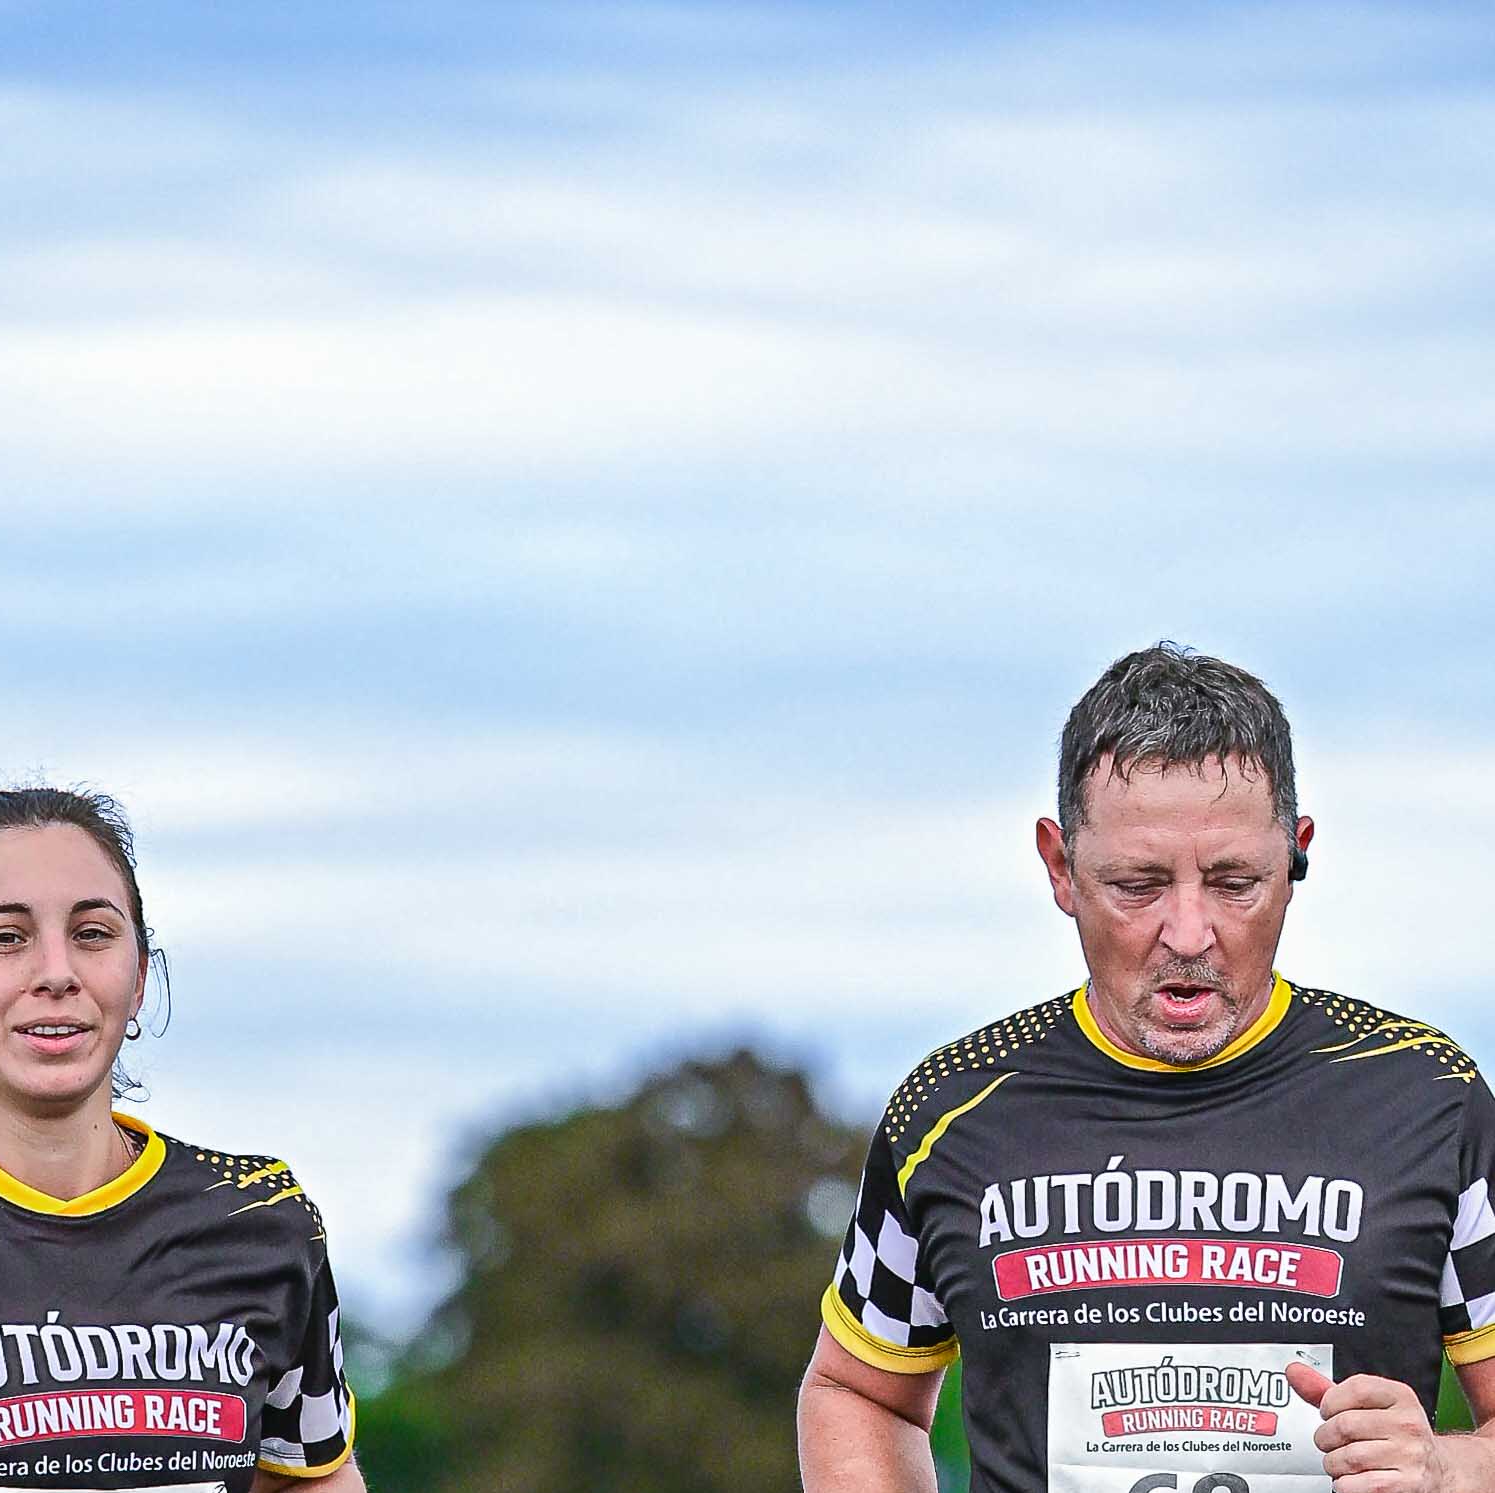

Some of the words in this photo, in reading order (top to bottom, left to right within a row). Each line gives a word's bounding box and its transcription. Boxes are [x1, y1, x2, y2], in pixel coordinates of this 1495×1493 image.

[977, 1155, 1365, 1249] AUTÓDROMO
[1023, 1243, 1188, 1291] RUNNING
[1200, 1244, 1302, 1287] RACE
[980, 1310, 997, 1330] La
[998, 1306, 1068, 1328] Carrera
[1074, 1302, 1102, 1325] de
[1107, 1302, 1141, 1323] los
[1145, 1301, 1224, 1323] Clubes
[1229, 1300, 1265, 1323] del
[1270, 1301, 1366, 1327] Noroeste
[1090, 1356, 1290, 1410] AUTÓDROMO
[145, 1394, 223, 1436] RACE
[1121, 1408, 1204, 1434] RUNNING
[1209, 1408, 1257, 1433] RACE
[34, 1454, 61, 1475] de
[65, 1453, 93, 1473] los
[97, 1451, 164, 1473] Clubes
[167, 1450, 197, 1472] del
[201, 1450, 256, 1470] Noroeste
[1086, 1441, 1099, 1453] La
[1102, 1441, 1144, 1453] Carrera
[1146, 1441, 1161, 1453] de
[1163, 1441, 1180, 1453] los
[1182, 1440, 1220, 1453] Clubes
[1222, 1440, 1240, 1452] del
[1242, 1440, 1292, 1453] Noroeste
